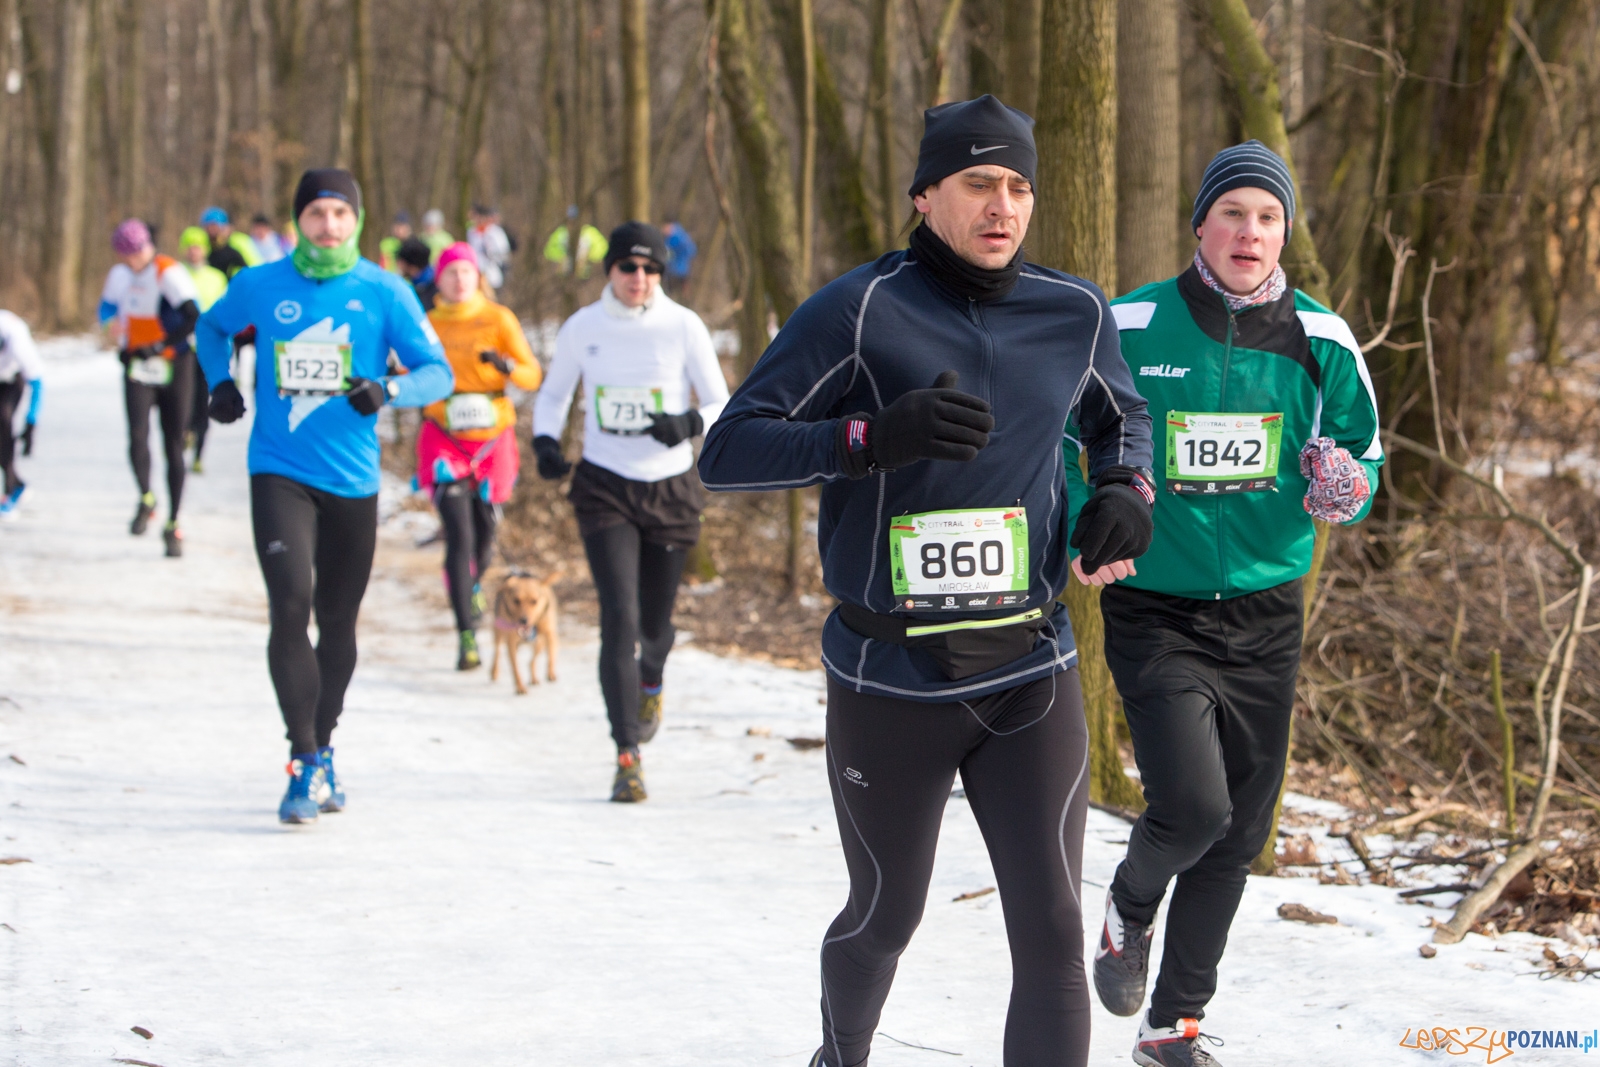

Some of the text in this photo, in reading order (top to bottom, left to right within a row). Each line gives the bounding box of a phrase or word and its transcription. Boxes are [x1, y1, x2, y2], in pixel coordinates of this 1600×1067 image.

[285, 359, 339, 379] 1523
[1138, 364, 1191, 378] saller
[611, 401, 645, 420] 731
[1184, 439, 1262, 466] 1842
[920, 540, 1004, 579] 860
